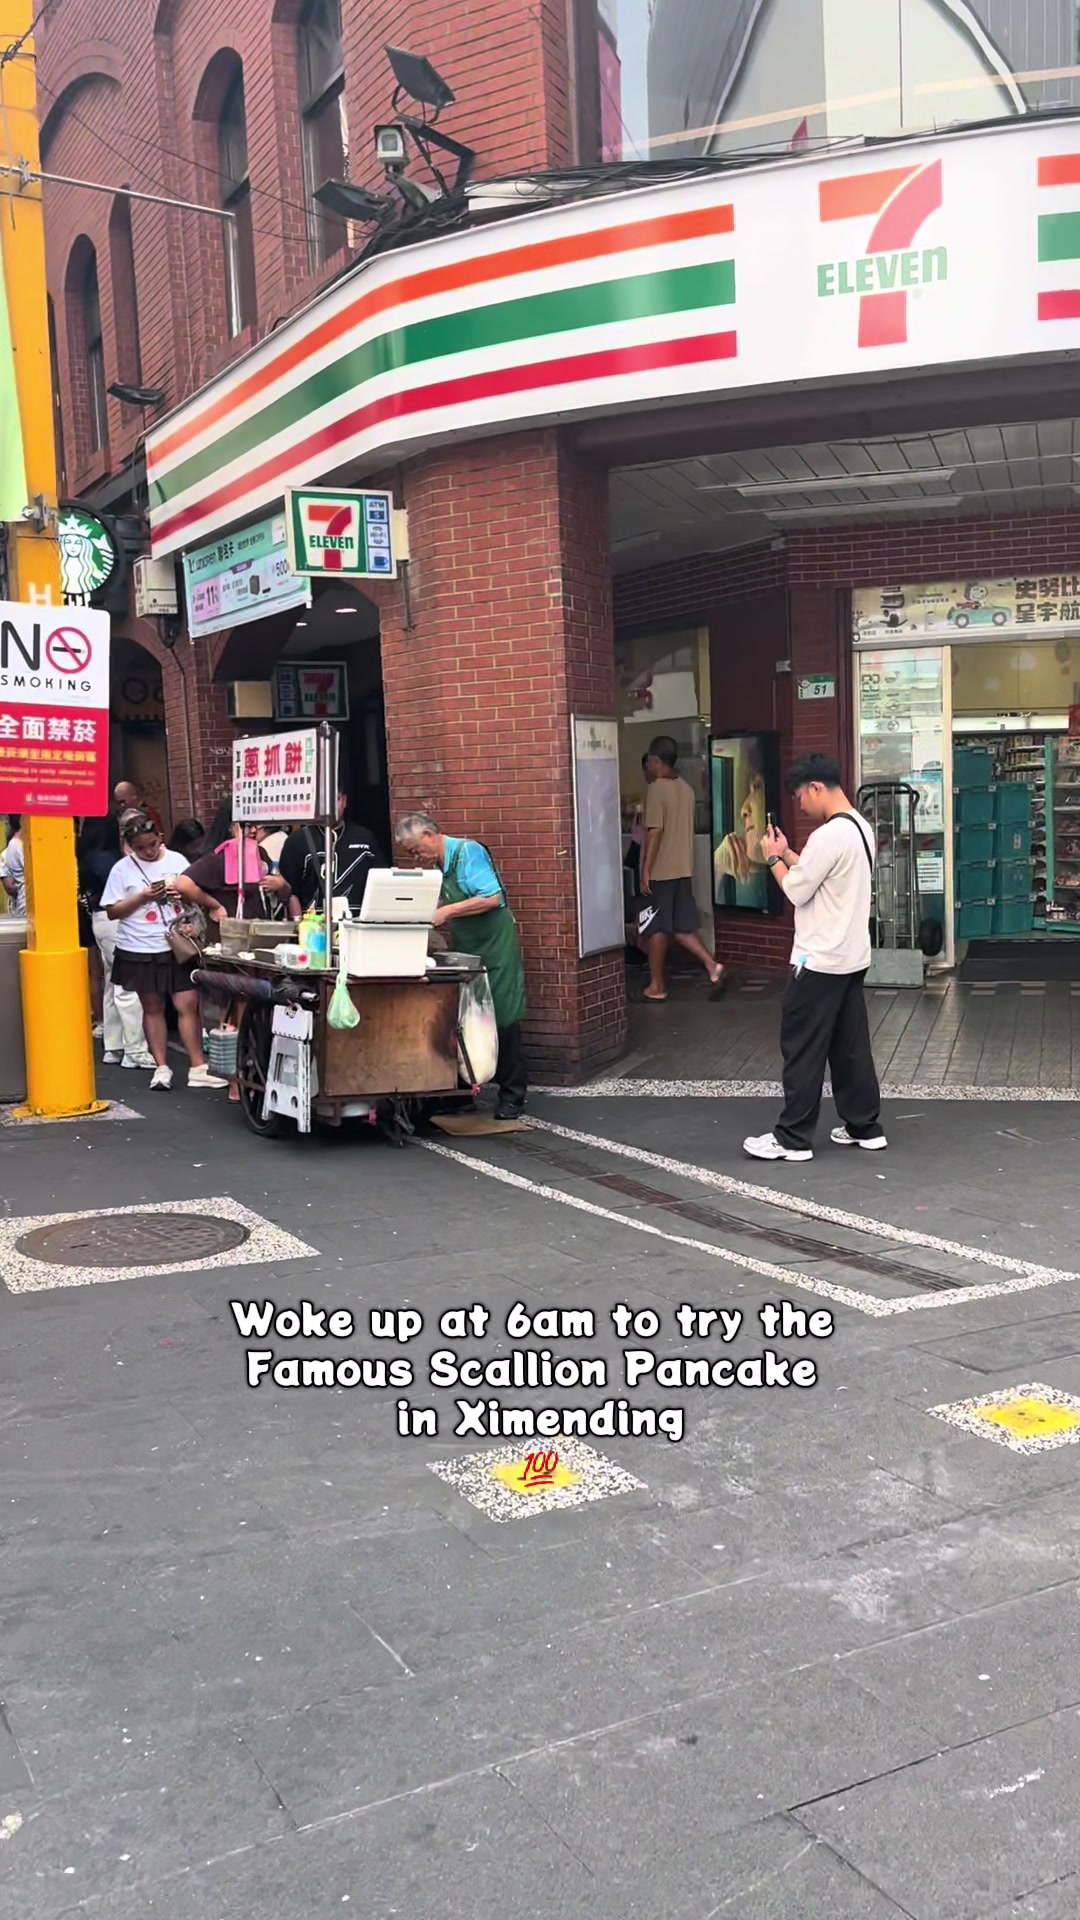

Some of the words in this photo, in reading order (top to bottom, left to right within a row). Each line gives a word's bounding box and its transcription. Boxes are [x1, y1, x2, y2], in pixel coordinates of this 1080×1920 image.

[818, 158, 943, 349] 7
[1015, 575, 1080, 600] 史努比
[1, 674, 92, 691] SMOKING
[813, 684, 828, 696] 51
[0, 713, 97, 743] 全面禁菸
